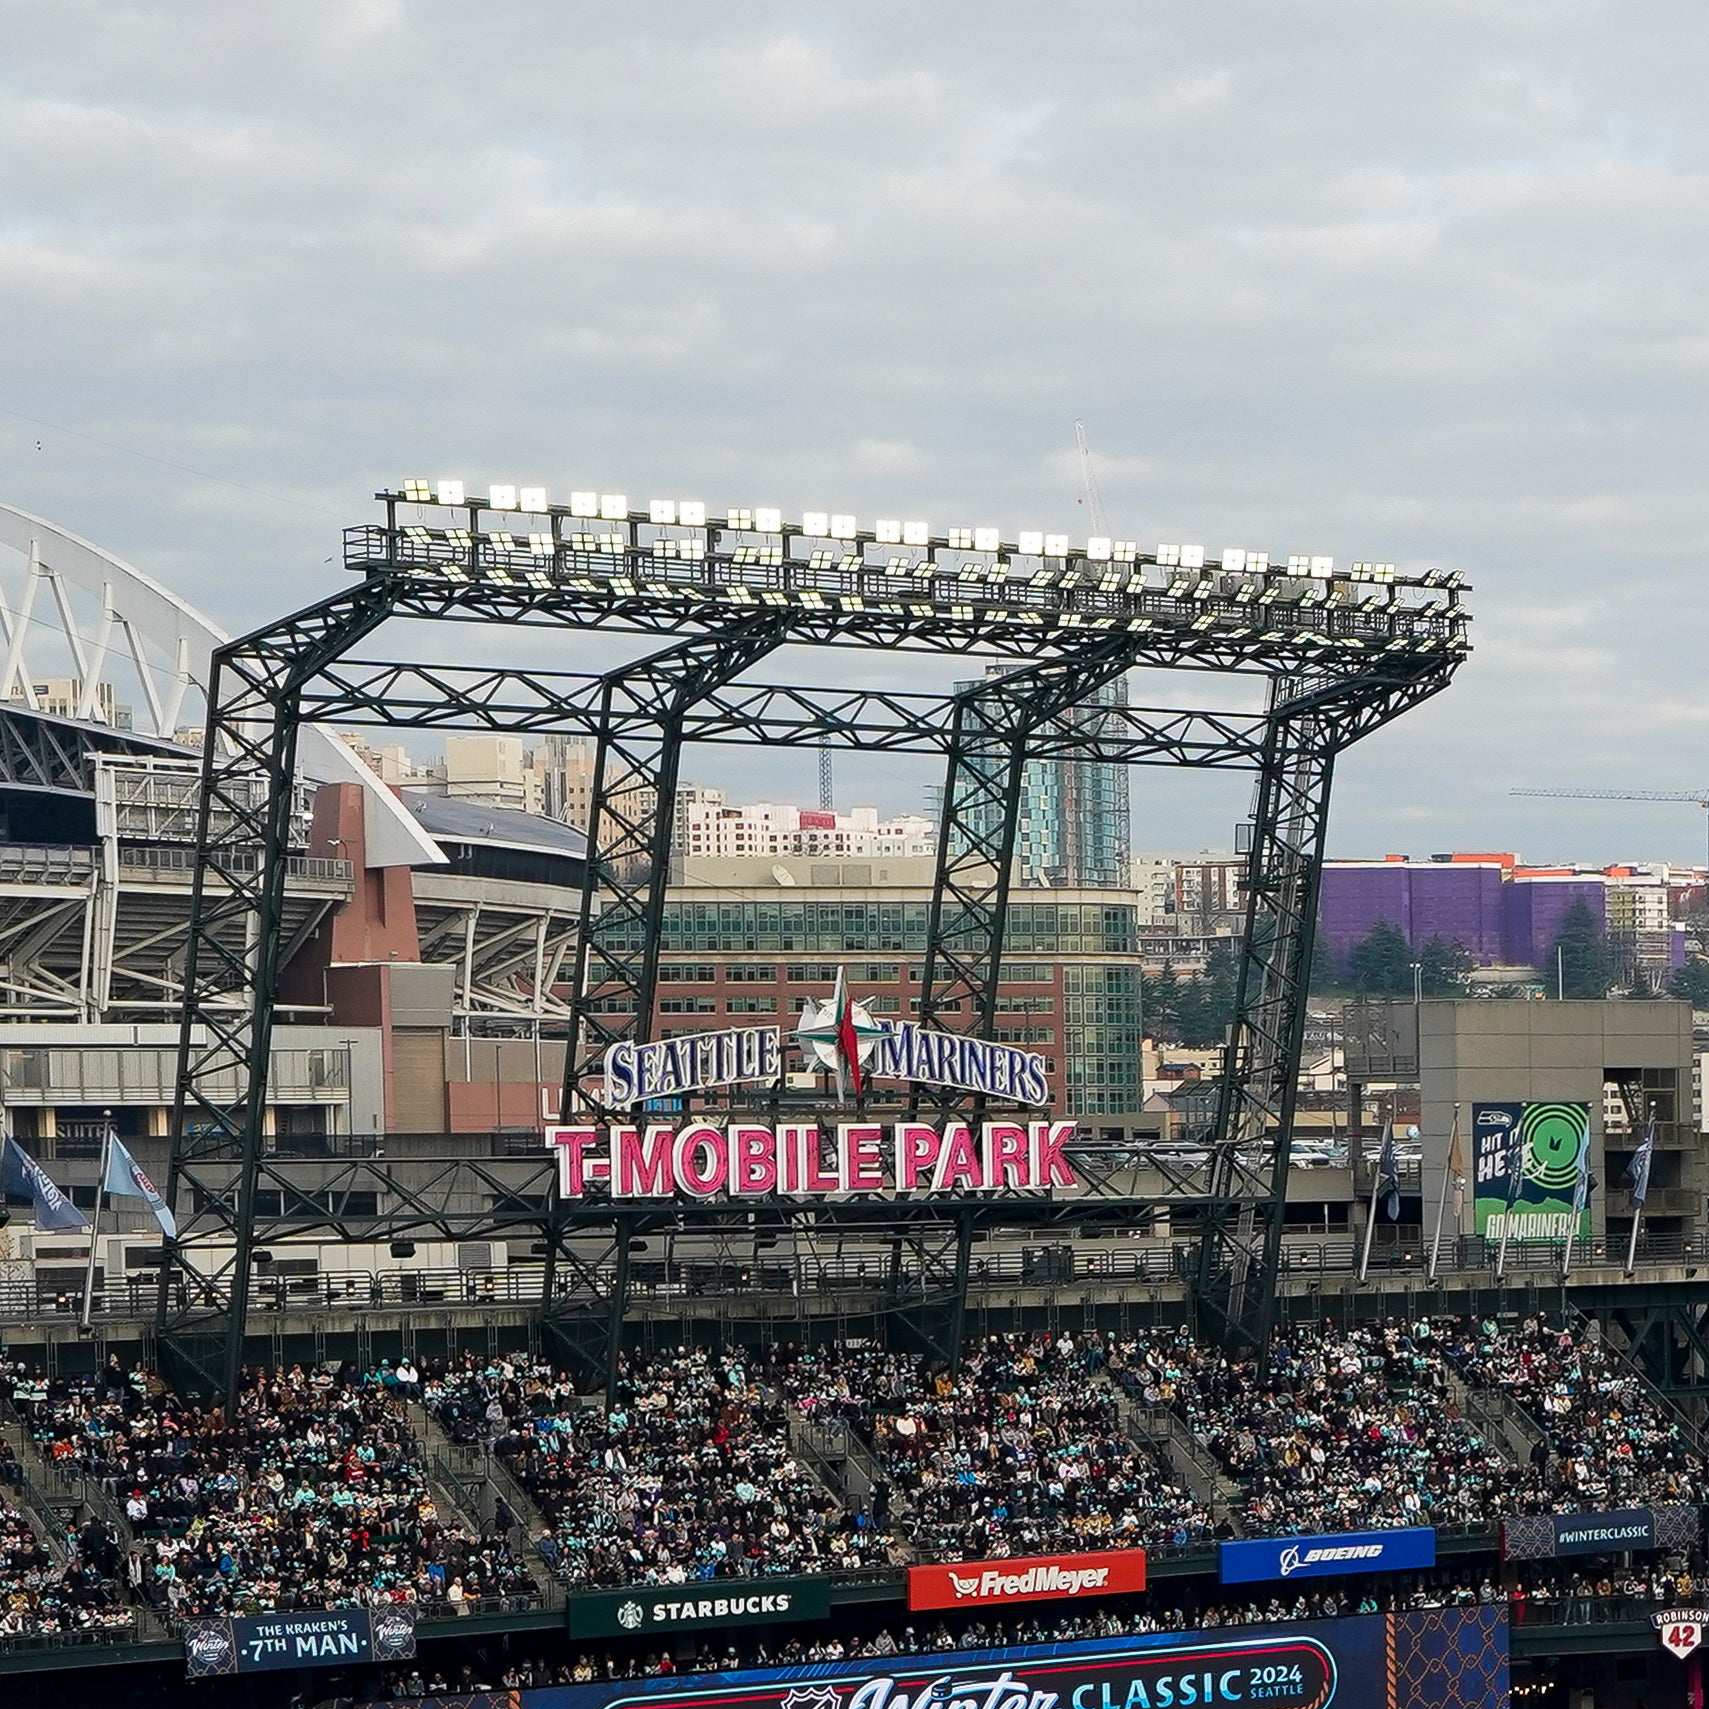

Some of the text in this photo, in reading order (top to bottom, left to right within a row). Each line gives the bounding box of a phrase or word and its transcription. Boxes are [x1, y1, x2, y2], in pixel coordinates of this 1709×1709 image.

[606, 1025, 782, 1107] SEATTLE
[873, 1018, 1048, 1106] MARINERS
[1481, 1132, 1504, 1154] HIT
[545, 1119, 1079, 1200] T-MOBILE PARK
[1559, 1525, 1650, 1543] #WINTERCLASSIC
[1304, 1543, 1384, 1563] BOEING
[652, 1594, 792, 1621] STARBUCKS
[1656, 1610, 1709, 1624] ROBINSON
[257, 1619, 349, 1637] THE KRAKEN'S
[1668, 1625, 1696, 1647] 42
[249, 1632, 359, 1662] 7TH MAN
[1250, 1666, 1302, 1685] 2024
[1250, 1683, 1303, 1699] SEATTLE
